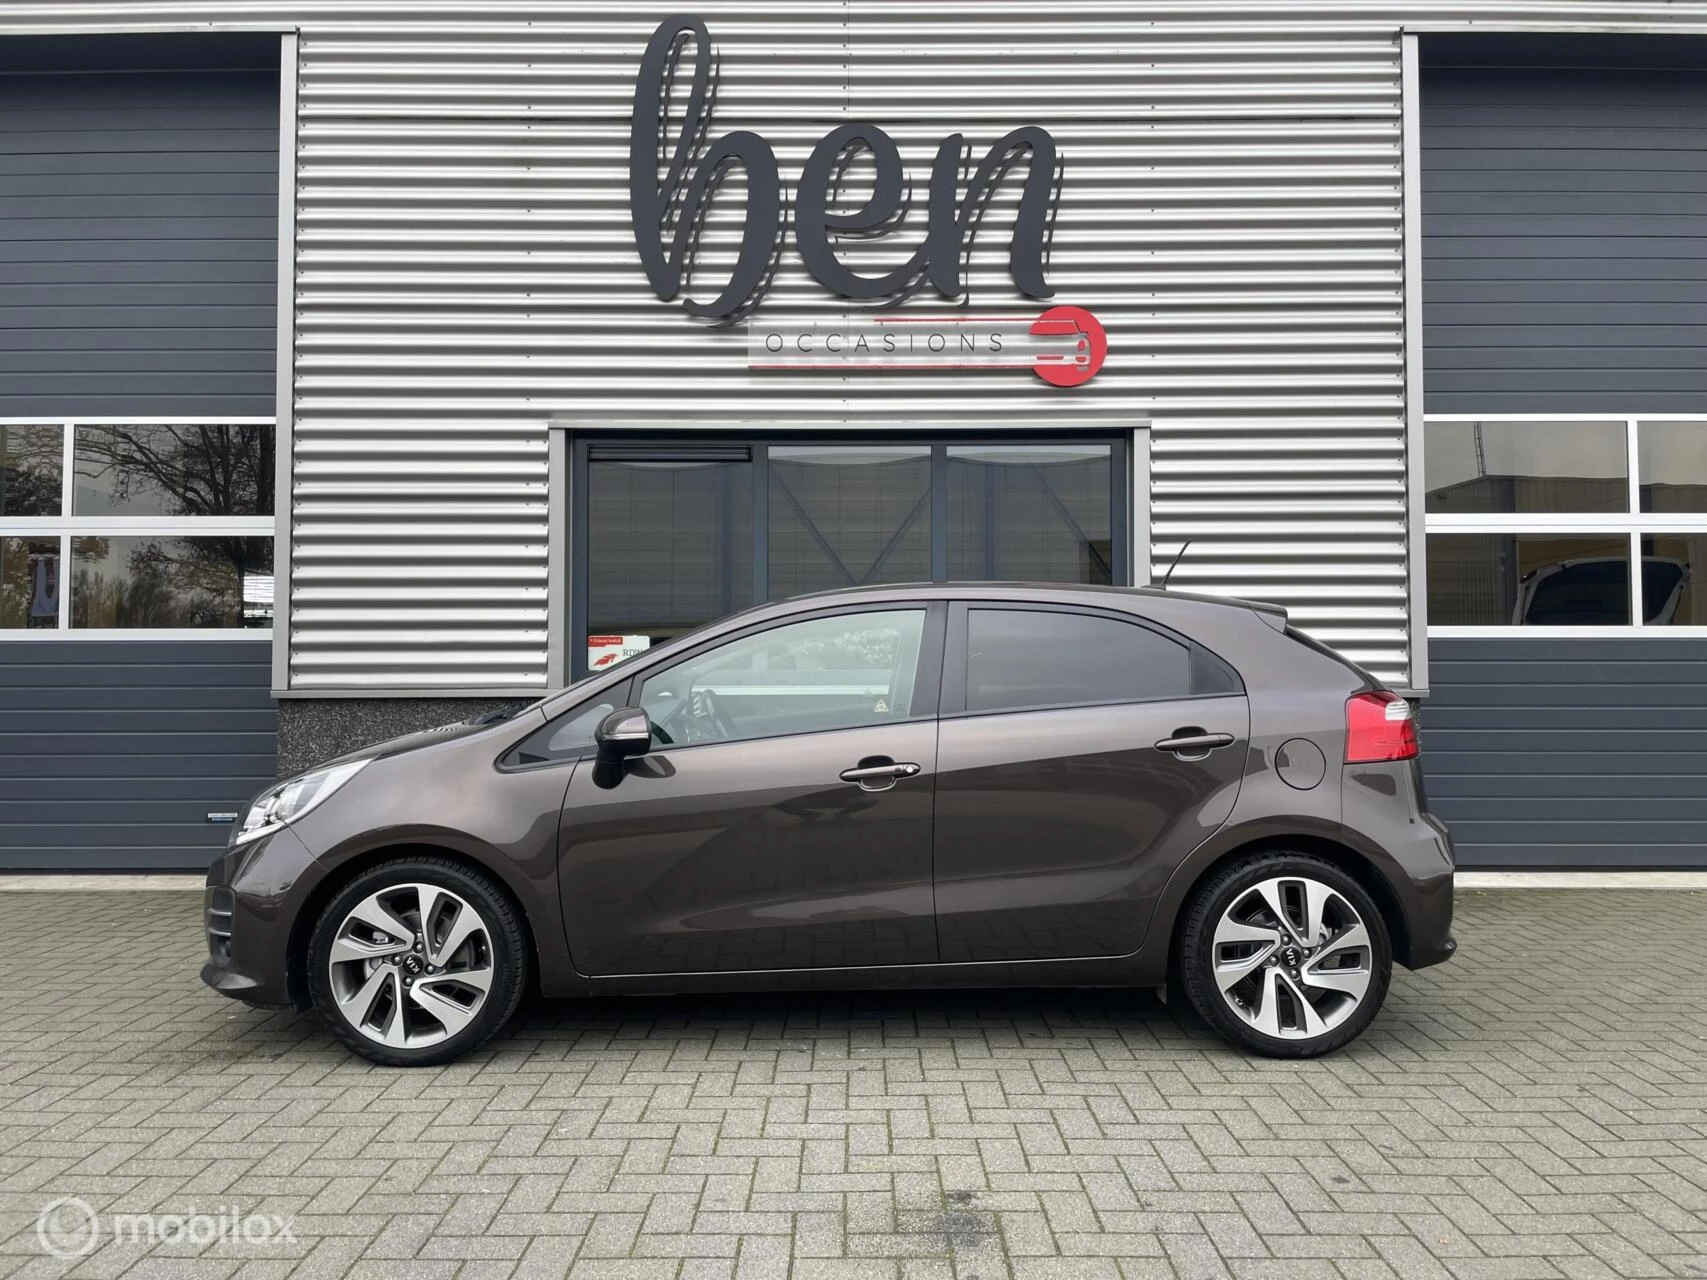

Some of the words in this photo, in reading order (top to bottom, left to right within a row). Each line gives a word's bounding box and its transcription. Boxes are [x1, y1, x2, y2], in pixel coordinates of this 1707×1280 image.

[630, 14, 1056, 318] ben
[765, 332, 1003, 353] OCCASIONS
[406, 956, 420, 973] KIA
[1286, 948, 1297, 966] KIA
